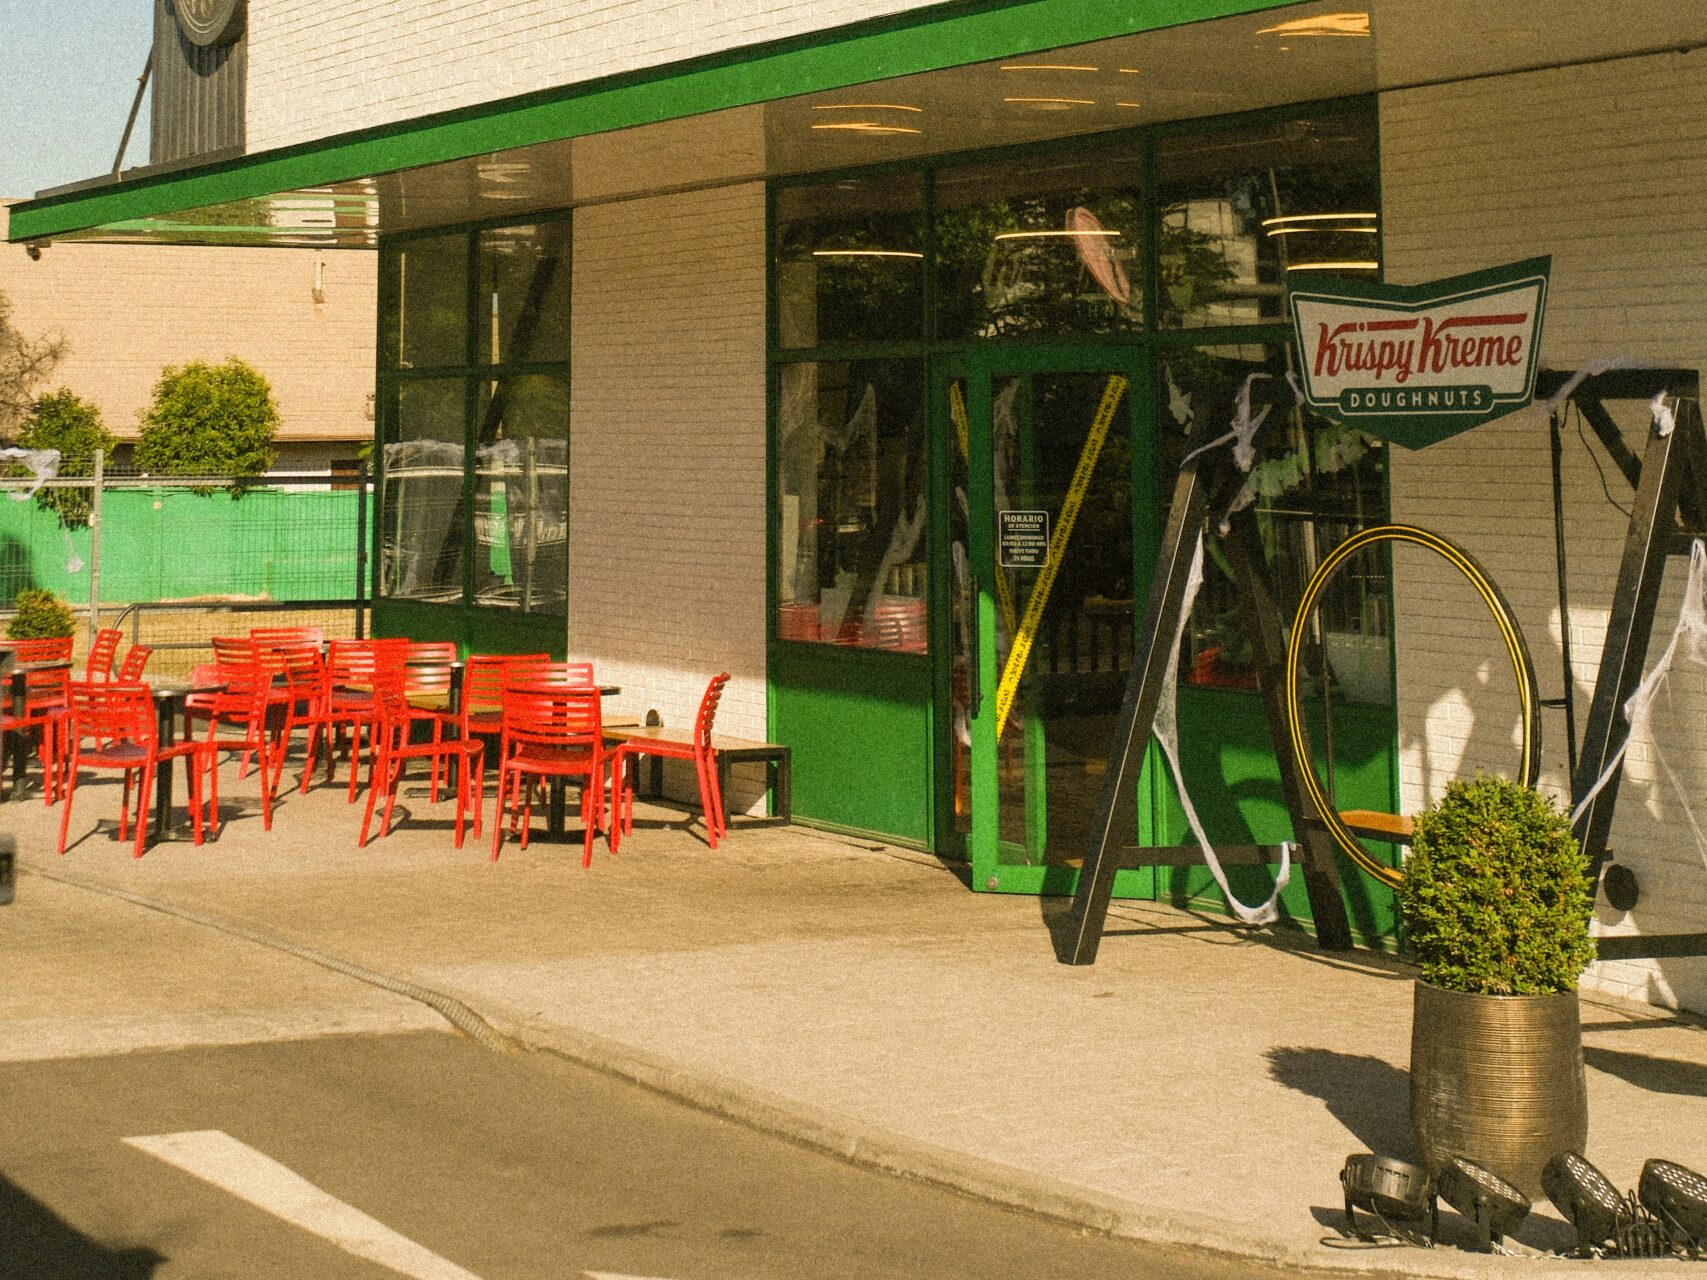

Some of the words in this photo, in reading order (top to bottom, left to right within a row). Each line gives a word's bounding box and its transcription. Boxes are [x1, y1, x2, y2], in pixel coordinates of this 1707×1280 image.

[1314, 318, 1419, 383] Krispy
[1418, 313, 1528, 373] Kreme
[1351, 390, 1482, 408] DOUGHNUTS
[1004, 515, 1043, 523] HORARIO
